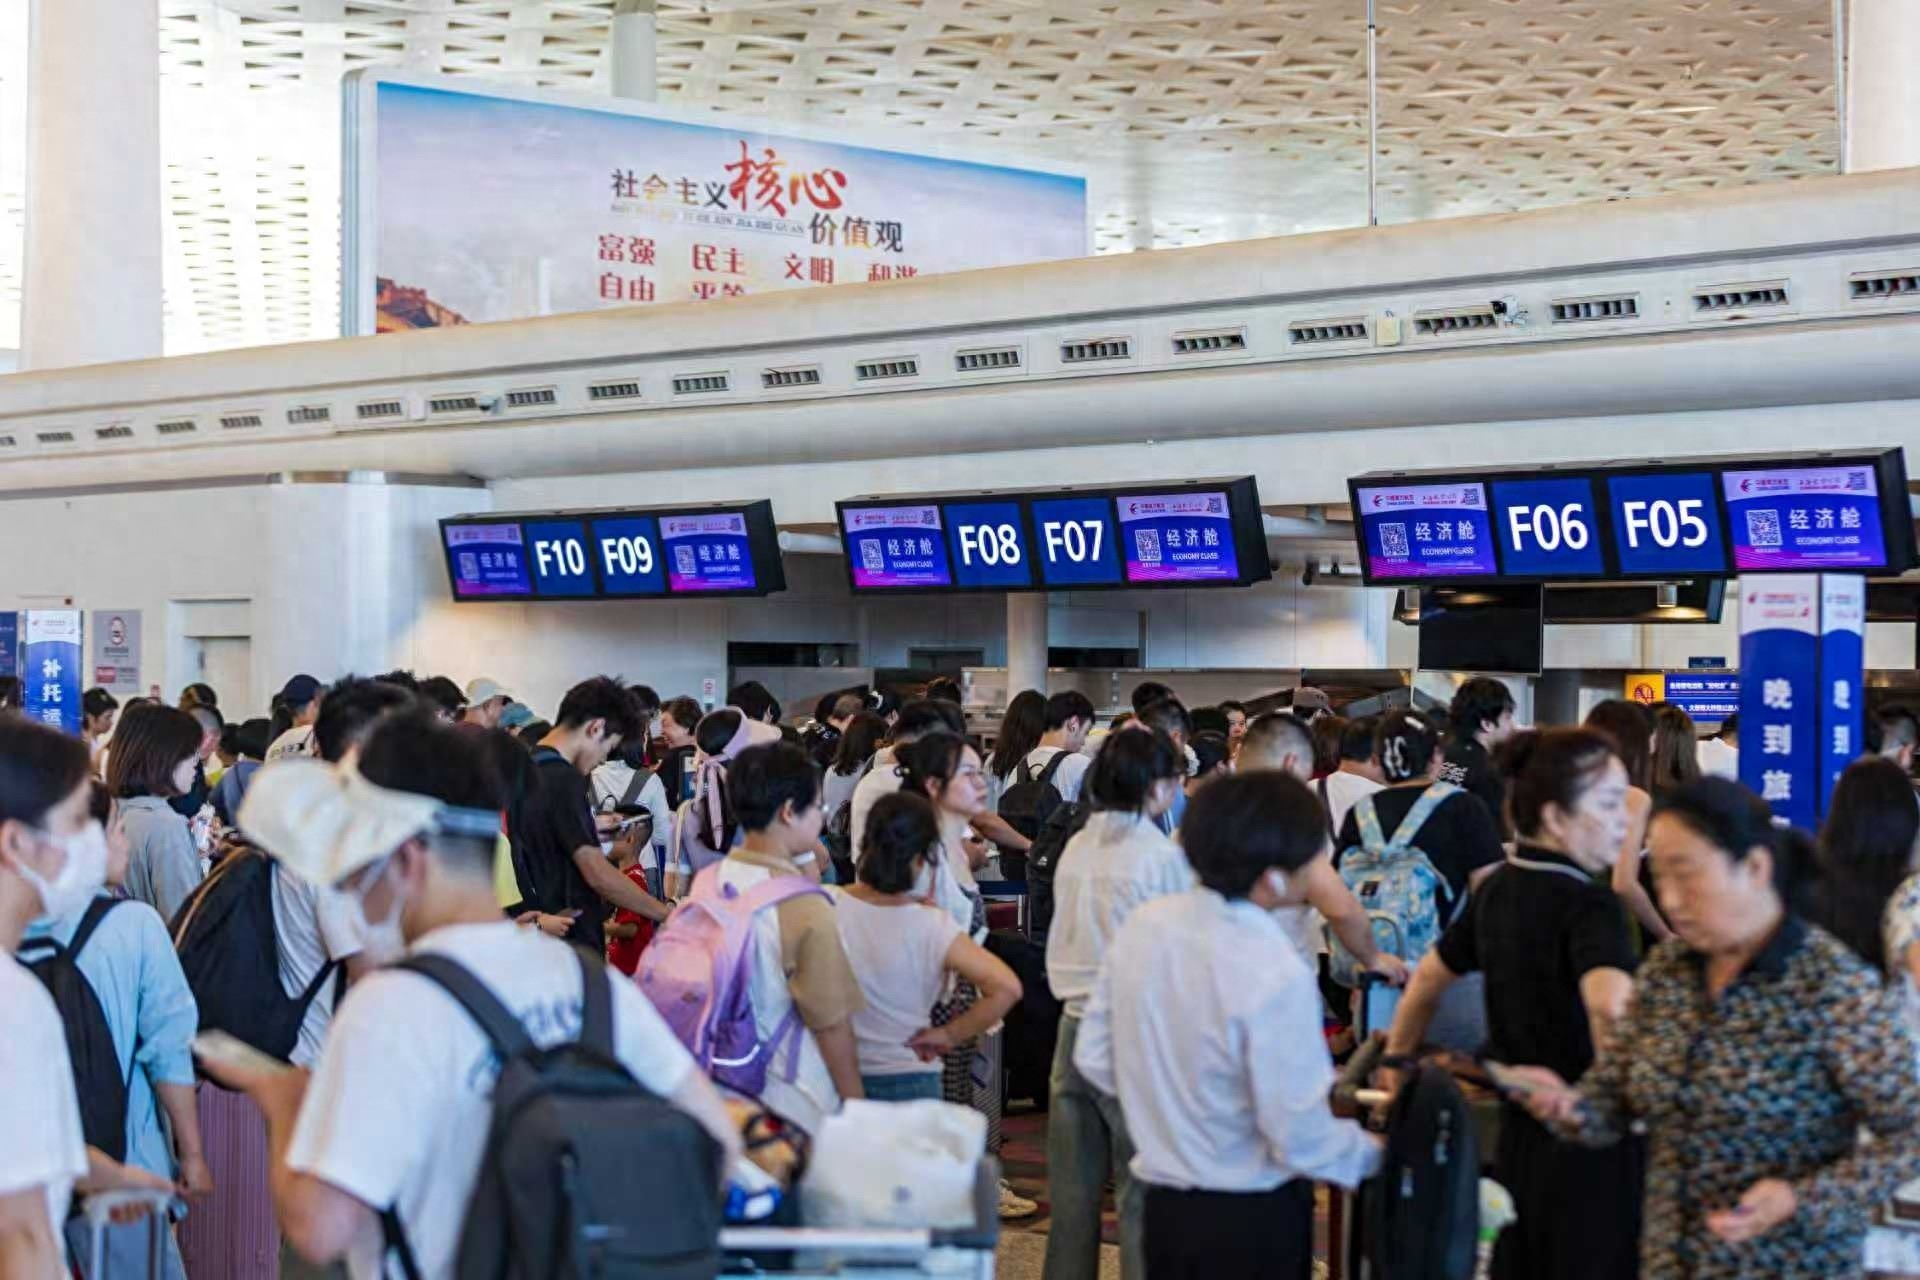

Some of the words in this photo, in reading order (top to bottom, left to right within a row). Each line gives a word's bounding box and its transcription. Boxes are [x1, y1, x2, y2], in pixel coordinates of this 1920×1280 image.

[611, 168, 728, 210] 社会主义
[724, 140, 847, 217] 核心
[808, 212, 903, 252] 价值观
[598, 233, 655, 266] 富强
[692, 244, 747, 276] 民主
[784, 253, 834, 283] 文明
[600, 272, 655, 301] 自由
[1166, 528, 1219, 547] 经济舱
[1415, 520, 1476, 541] 经济舱
[1507, 502, 1589, 551] F06
[1622, 499, 1708, 548] F05
[1789, 507, 1862, 529] 经济舱
[535, 539, 585, 577] F10
[601, 536, 653, 575] F09
[887, 538, 934, 556] 经济舱
[958, 524, 1021, 566] F08
[1043, 520, 1104, 563] F07
